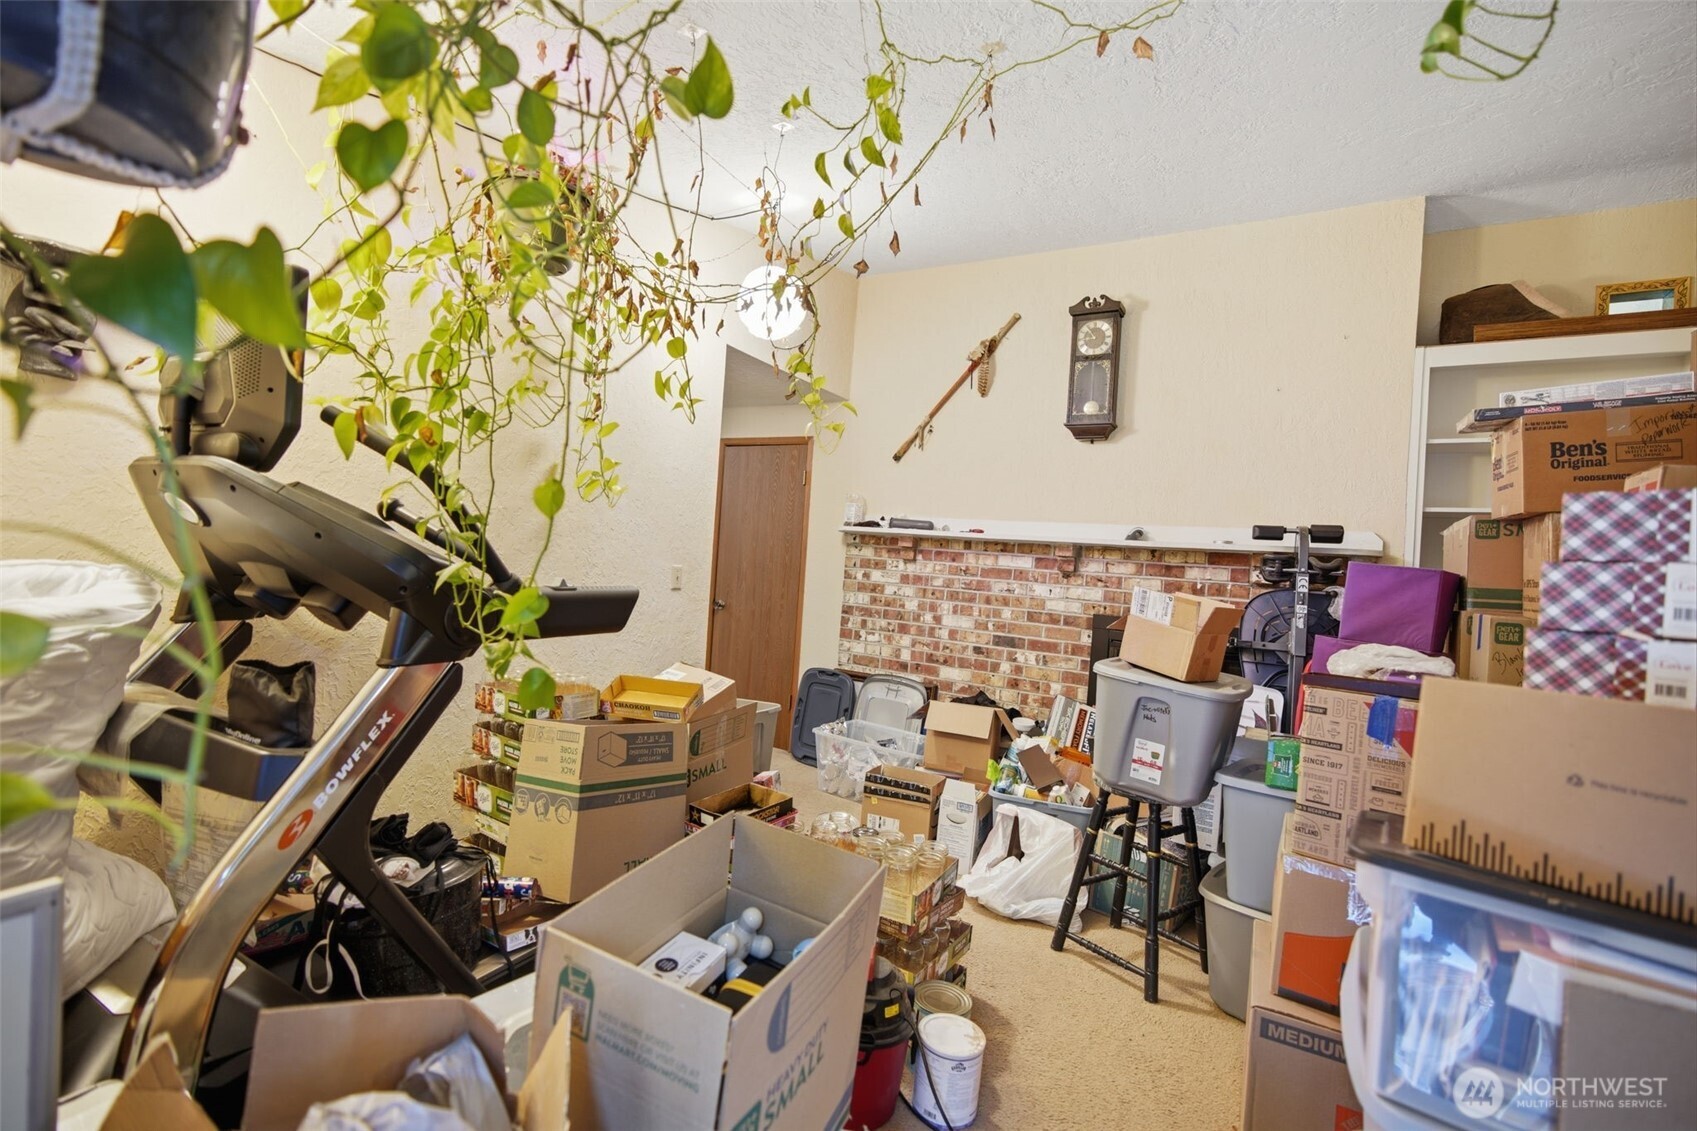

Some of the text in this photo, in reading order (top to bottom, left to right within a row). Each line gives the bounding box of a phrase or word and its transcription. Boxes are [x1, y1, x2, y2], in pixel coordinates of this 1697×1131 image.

[1550, 439, 1608, 458] Ben's
[1550, 457, 1608, 471] Original
[1478, 528, 1498, 537] GEAR
[1498, 632, 1520, 642] GEAR
[313, 710, 394, 809] BOWFLEX
[560, 755, 577, 765] MOVE
[1302, 756, 1325, 767] SINCE
[1327, 760, 1343, 770] 1917
[1367, 755, 1407, 768] DELICIOUS
[560, 766, 576, 776] PACK
[692, 758, 728, 782] SMALL
[1267, 1023, 1346, 1059] MEDIUM
[763, 1040, 825, 1131] SMALL
